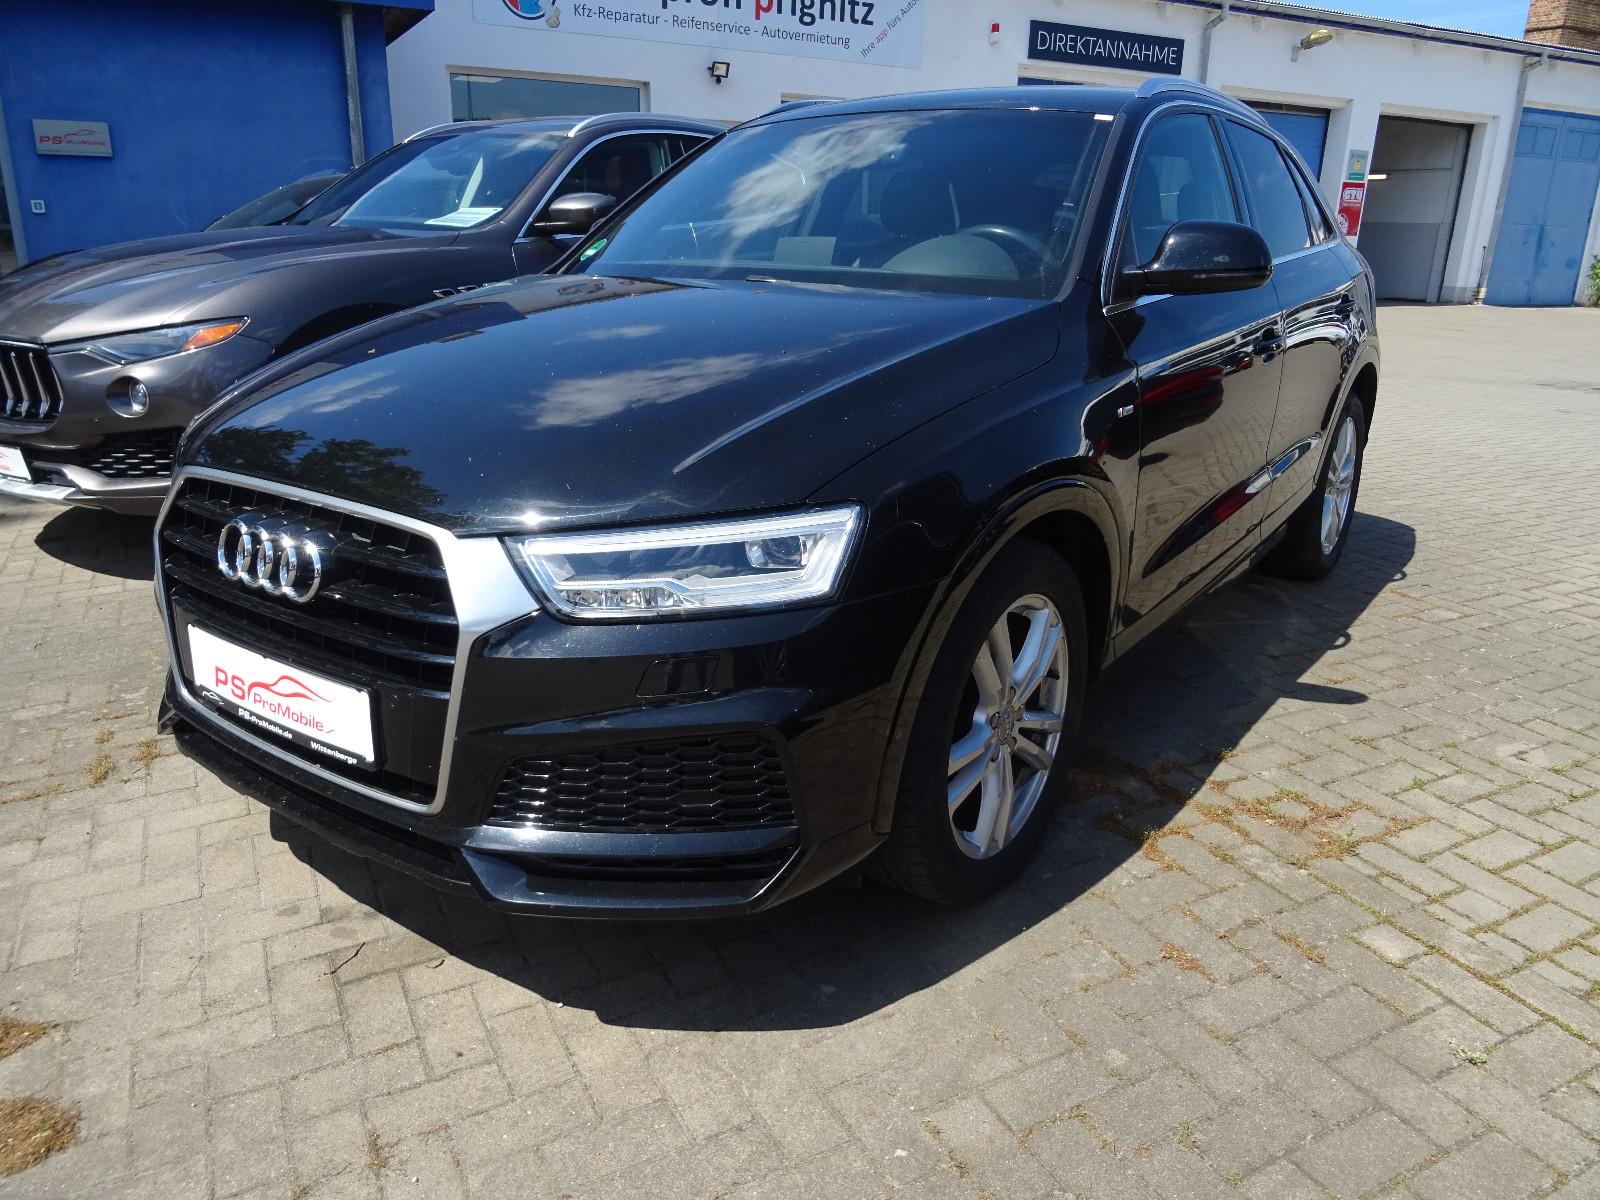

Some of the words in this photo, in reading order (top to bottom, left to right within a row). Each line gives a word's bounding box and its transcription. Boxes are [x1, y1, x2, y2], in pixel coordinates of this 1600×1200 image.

[574, 4, 660, 24] Kfz-Reparatur
[673, 14, 750, 35] Reifenservice
[761, 25, 851, 49] Autovermietung
[860, 42, 876, 58] Ihre
[875, 28, 889, 44] app
[1037, 30, 1178, 65] DIREKTANNAHME
[39, 135, 63, 145] PS
[214, 665, 246, 701] PS
[253, 692, 324, 732] ProMobile
[238, 707, 293, 739] PS-ProMobile.de
[310, 740, 358, 765] Wittenberge
